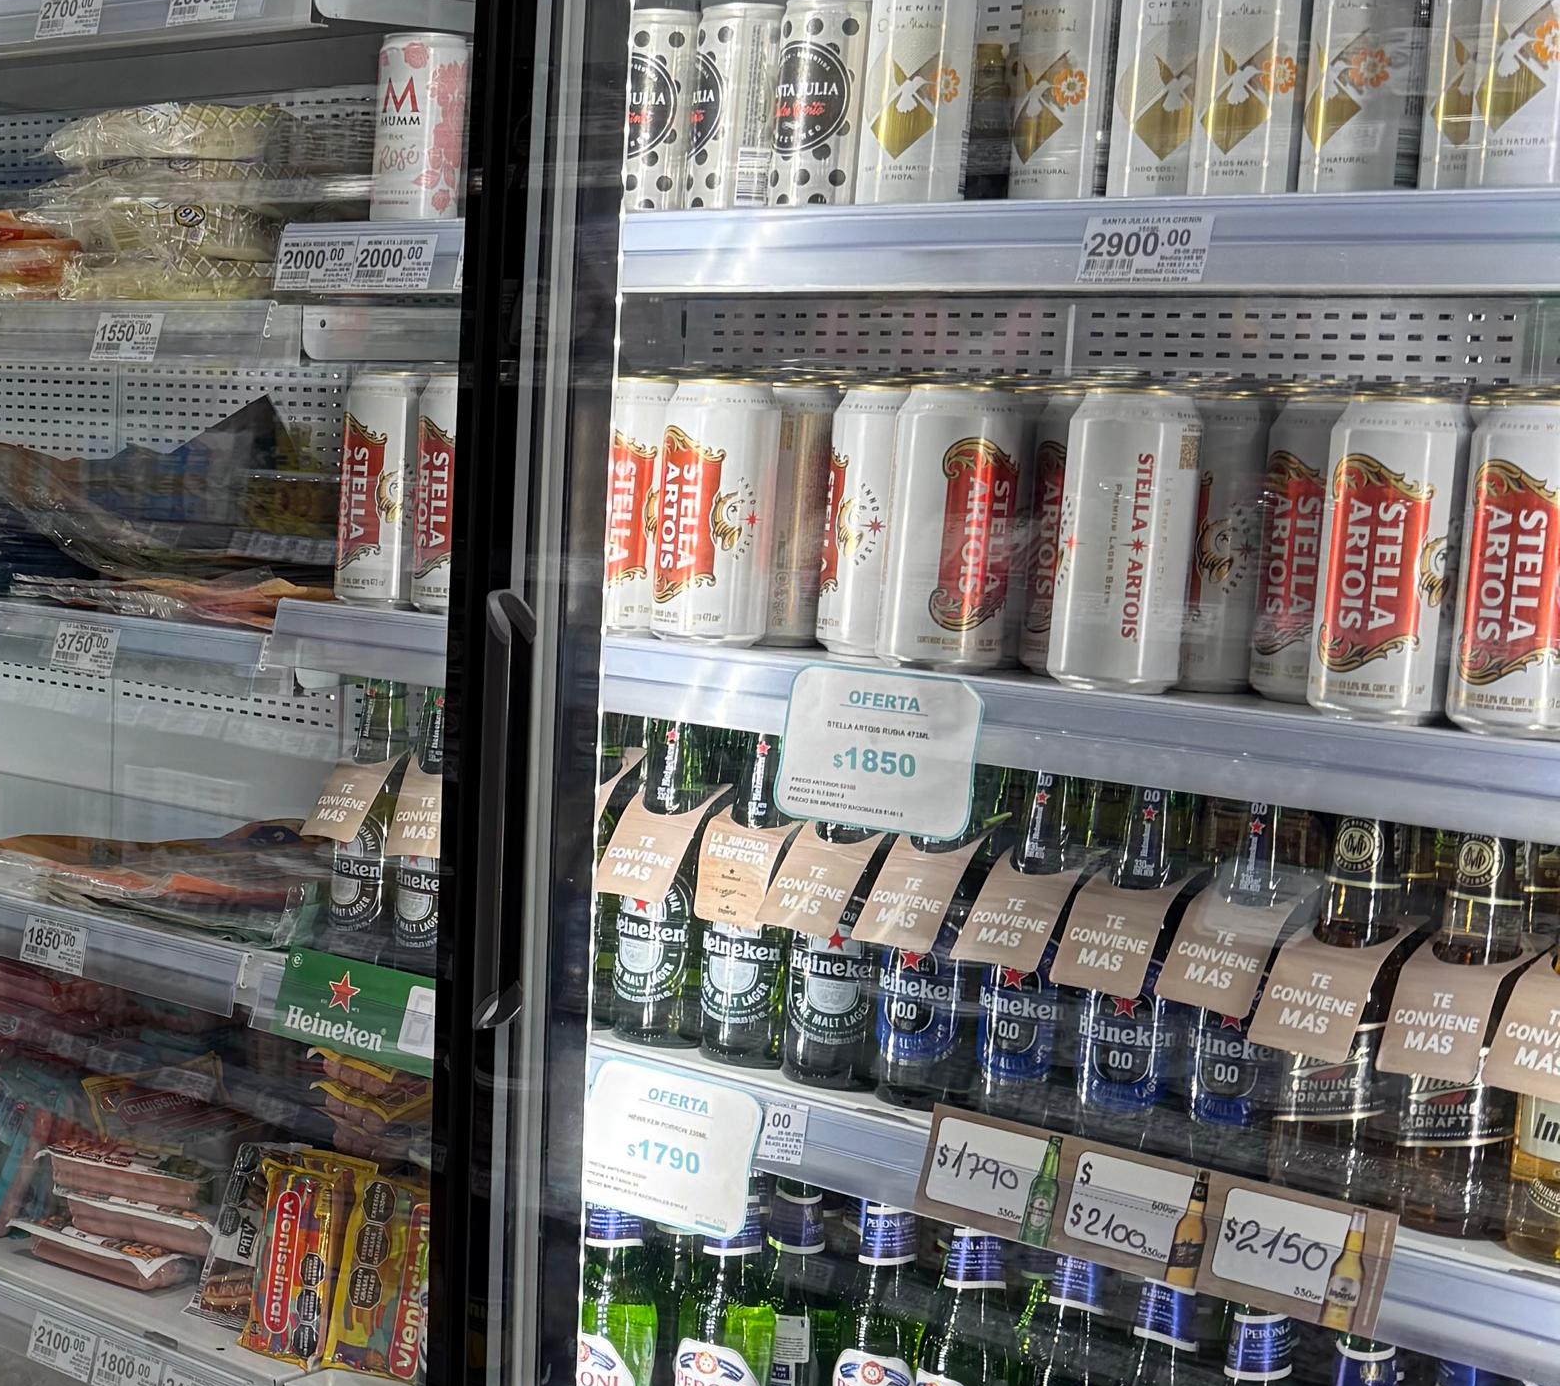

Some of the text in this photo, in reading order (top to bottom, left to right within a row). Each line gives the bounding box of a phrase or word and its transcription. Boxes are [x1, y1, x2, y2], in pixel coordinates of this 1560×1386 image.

[380, 116, 421, 127] MUMM
[349, 445, 368, 540] STELLA
[416, 450, 429, 549] ARTOIS
[429, 451, 449, 548] STELLA
[1132, 453, 1155, 533] STELLA
[660, 462, 680, 570] ARTOIS
[676, 464, 703, 570] STELLA
[959, 477, 985, 595] ARTOIS
[1339, 499, 1373, 630] ARTOIS
[1367, 502, 1406, 632] STELLA
[1476, 504, 1512, 642] ARTOIS
[1506, 509, 1548, 642] STELLA
[1121, 557, 1145, 643] ARTOIS
[849, 690, 921, 712] OFERTA
[833, 746, 916, 778] $1850
[341, 784, 354, 794] TE
[421, 796, 436, 808] TE
[318, 796, 366, 811] CONVIENE
[639, 836, 655, 848] TE
[708, 844, 765, 864] PERFECTA
[711, 833, 769, 851] LA JUNTADA
[609, 846, 675, 871] CONVIENE
[809, 865, 827, 879] TE
[905, 877, 923, 891] TE
[776, 876, 846, 902] CONVIENE
[872, 889, 943, 916] CONVIENE
[1007, 897, 1026, 912] TE
[971, 908, 1048, 934] CONVIENE
[1106, 914, 1124, 930] TE
[702, 931, 781, 963] Heineken
[1069, 926, 1149, 956] CONVIENE
[1216, 930, 1235, 947] TE
[1177, 941, 1260, 974] CONVIENE
[741, 982, 770, 1006] LAGER
[1311, 972, 1332, 990] TE
[896, 1002, 916, 1020] 0.0
[979, 989, 1065, 1021] Heineken
[1270, 984, 1356, 1017] CONVIENE
[283, 1004, 383, 1054] Heineken
[997, 1021, 1020, 1040] 0.0
[1394, 1008, 1480, 1034] CONVIENE
[1108, 1051, 1133, 1070] 0.0
[1214, 1063, 1239, 1084] 0.0
[648, 1087, 709, 1115] OFERTA
[627, 1139, 700, 1174] $1790
[937, 1142, 1019, 1191] $1790
[866, 1216, 902, 1229] PERONI
[1071, 1203, 1147, 1249] $2100
[1223, 1217, 1329, 1271] $2150
[1244, 1325, 1287, 1340] PERONI
